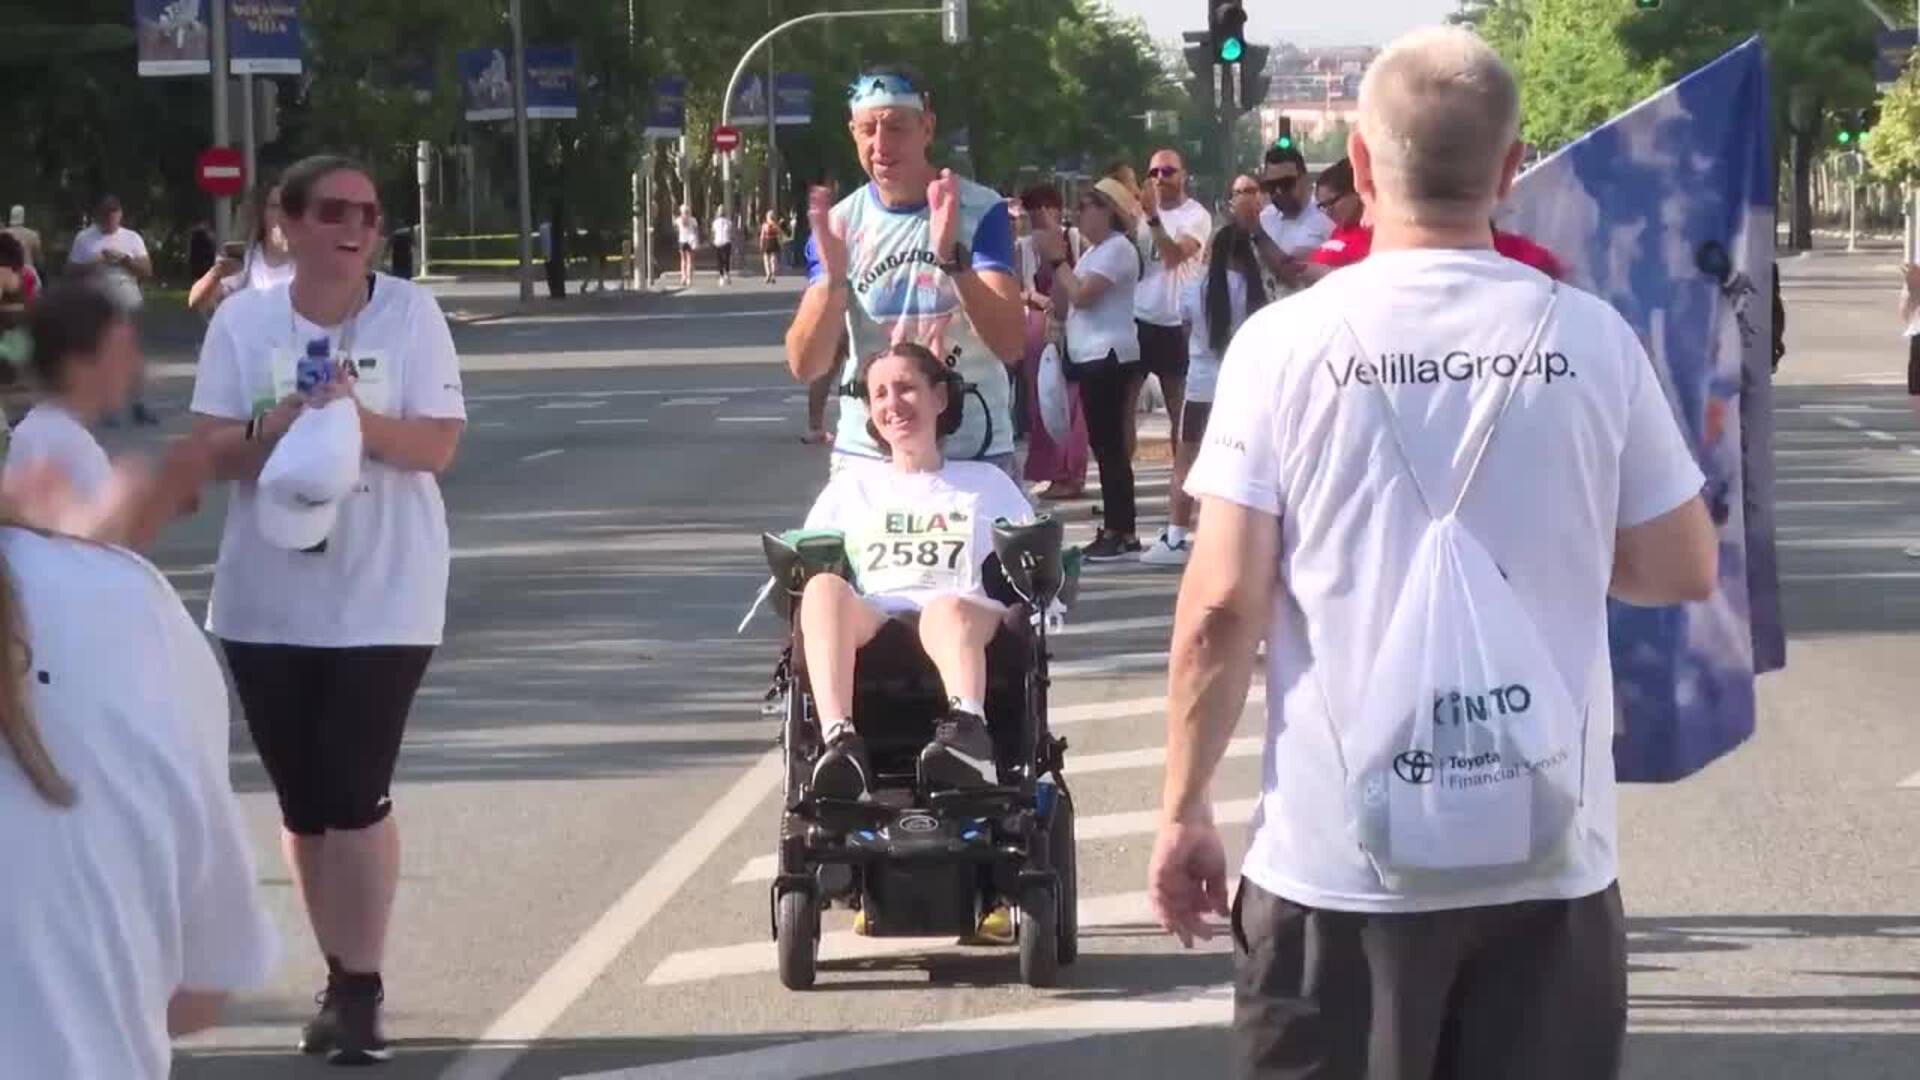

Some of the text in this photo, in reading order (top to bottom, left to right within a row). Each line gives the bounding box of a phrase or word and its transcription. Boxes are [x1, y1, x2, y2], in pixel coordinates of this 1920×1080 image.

[866, 540, 965, 572] 2587
[1448, 751, 1501, 771] Toyota
[1449, 763, 1520, 790] Financial
